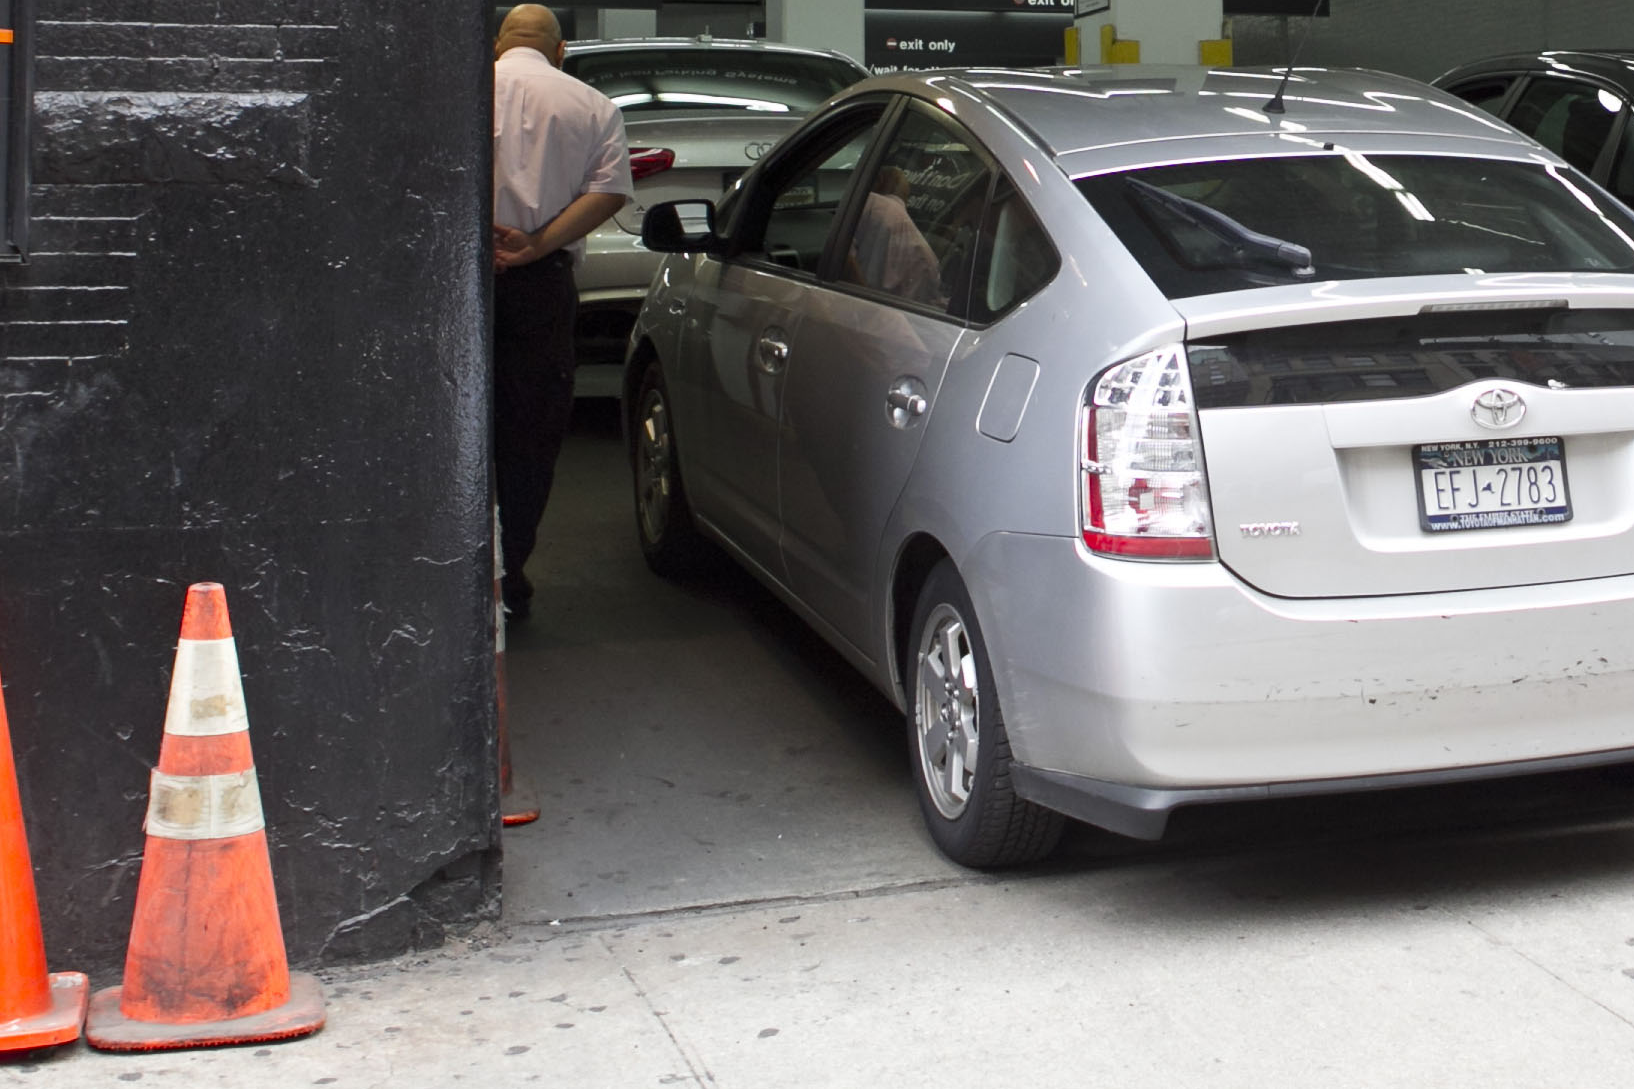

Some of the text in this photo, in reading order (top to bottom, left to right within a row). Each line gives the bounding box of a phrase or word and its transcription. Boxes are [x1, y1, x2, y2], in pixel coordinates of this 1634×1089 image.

[899, 38, 956, 53] exit only
[1421, 445, 1439, 453] NEW
[1488, 437, 1558, 449] 212-399-9600
[1453, 448, 1529, 466] NEW YORK
[1240, 521, 1300, 536] TOYOTA
